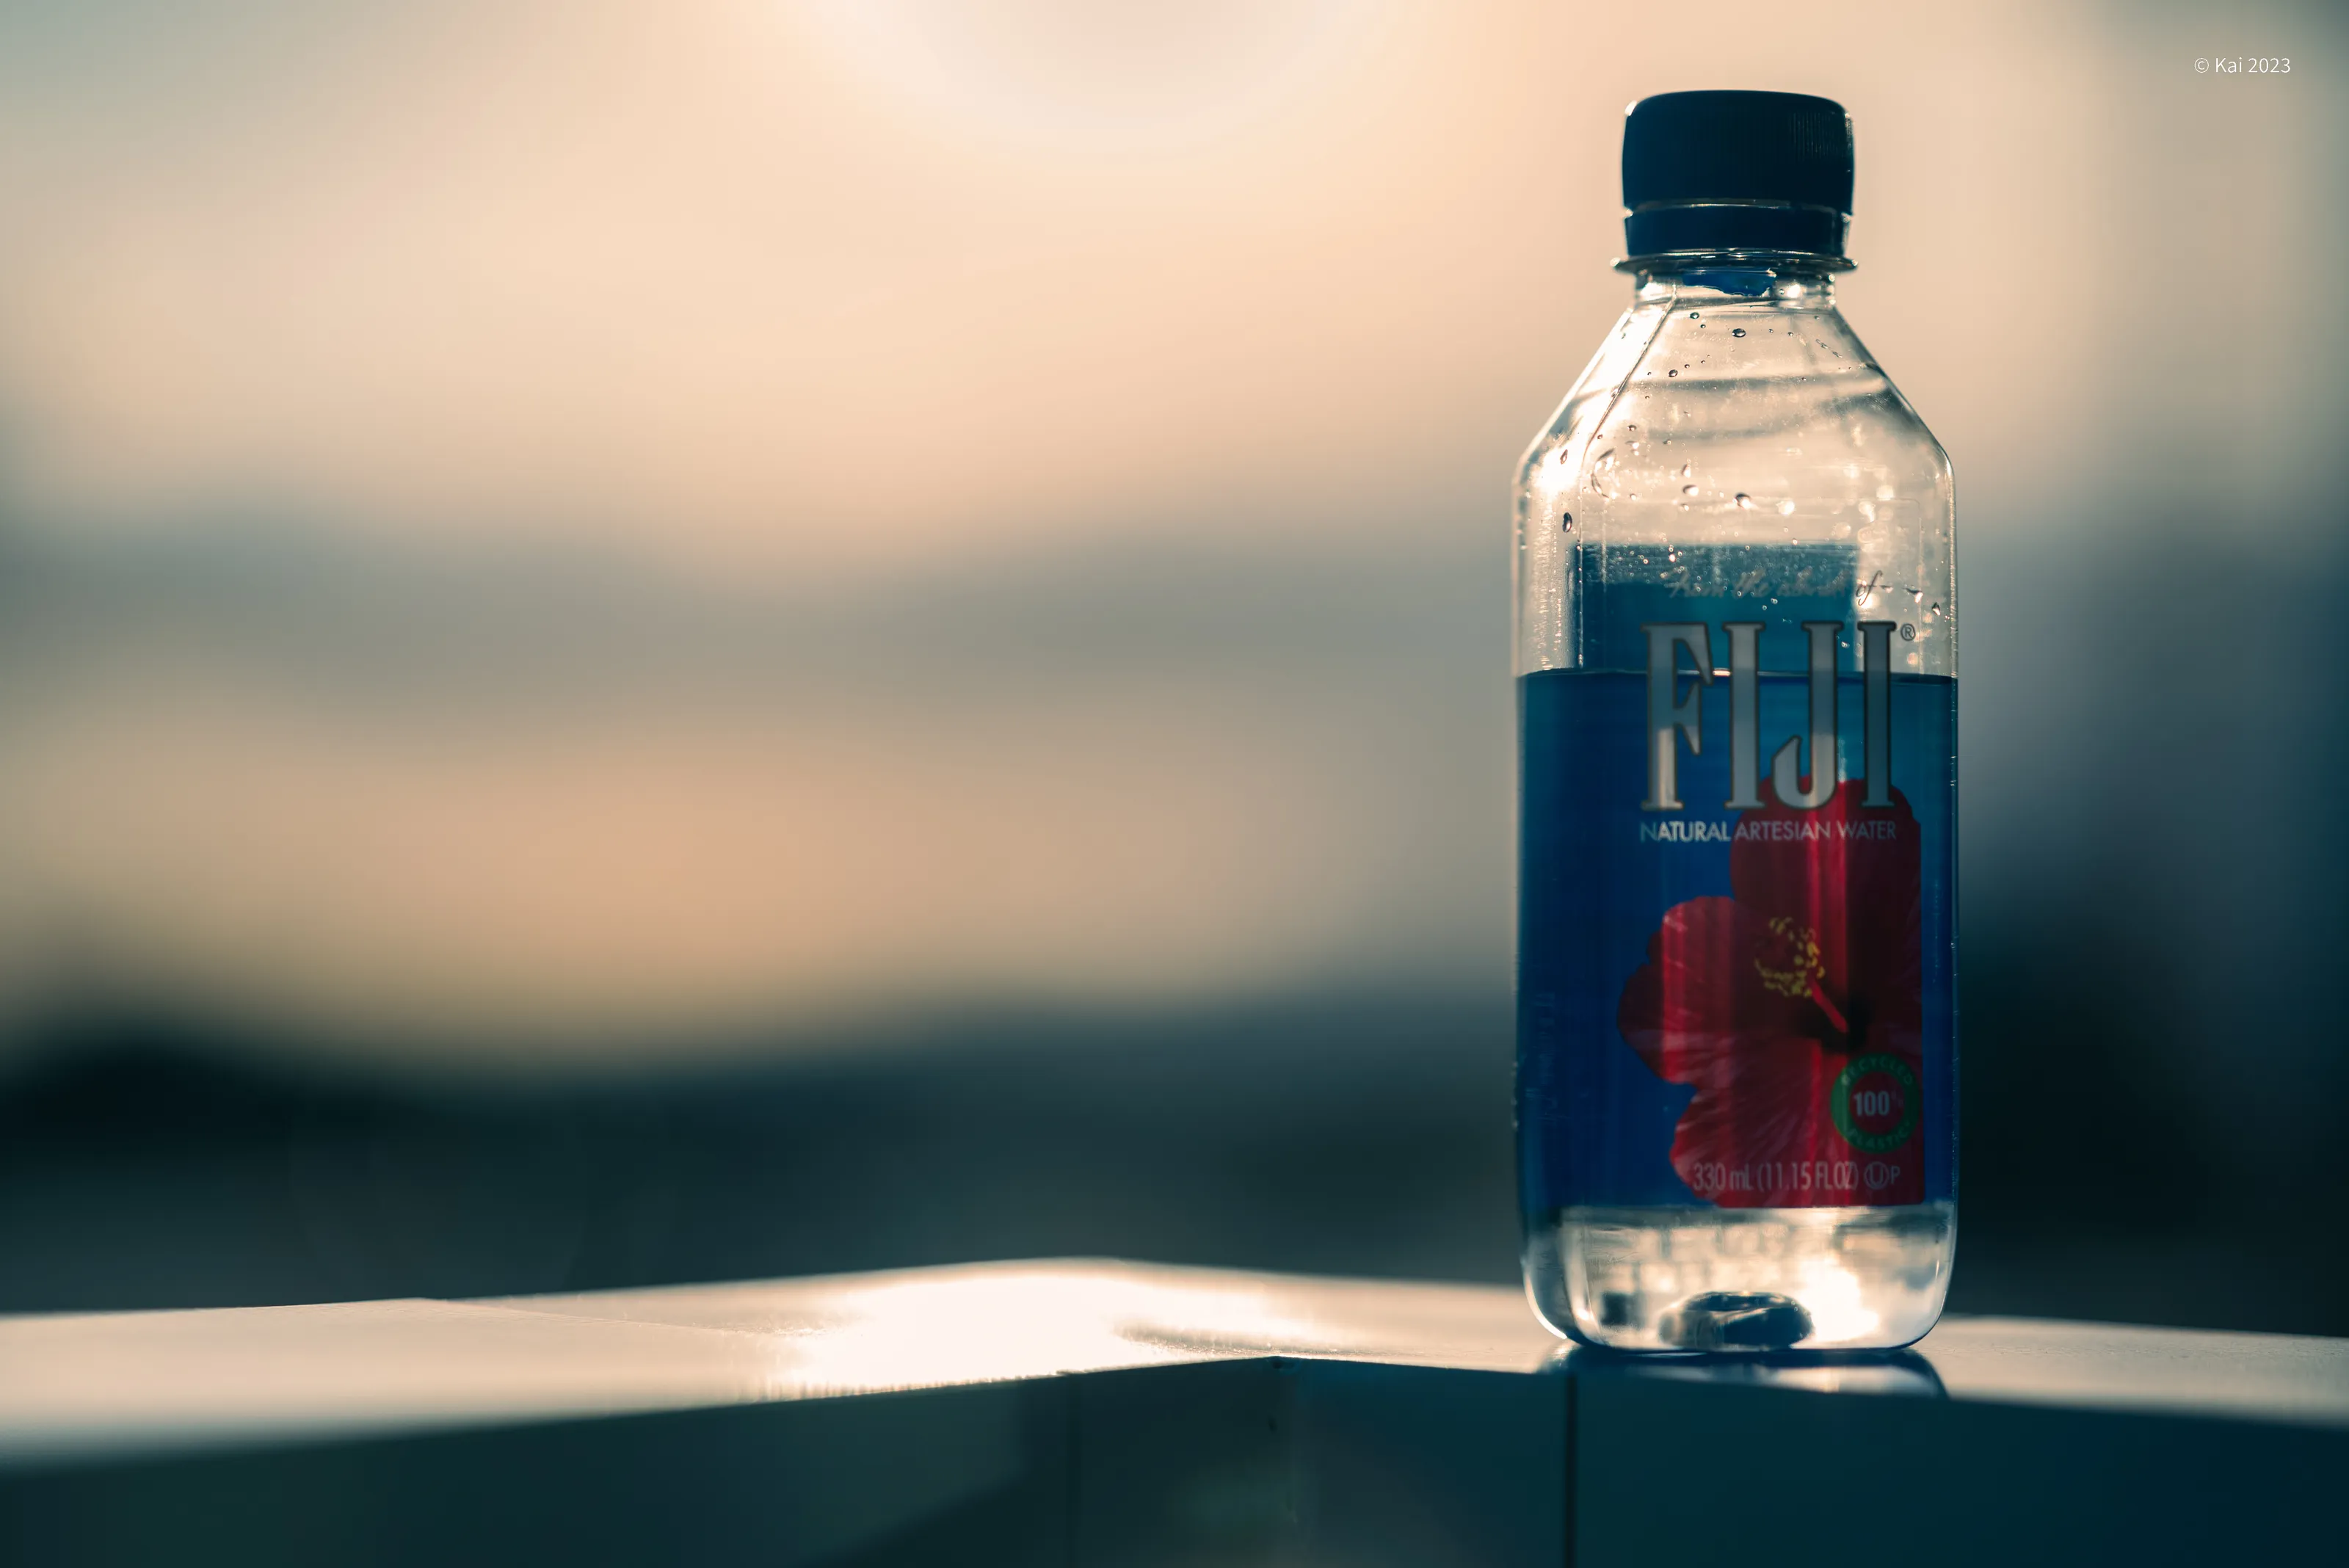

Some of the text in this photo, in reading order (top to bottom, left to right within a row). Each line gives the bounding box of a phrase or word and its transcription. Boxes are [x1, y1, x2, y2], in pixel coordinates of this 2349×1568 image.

[1856, 569, 1884, 606] of
[1639, 819, 1897, 842] NATURAL ARTESIAN WATER
[1693, 1161, 1727, 1191] 330
[1729, 1162, 1754, 1191] mL
[1757, 1161, 1812, 1194] (11.15
